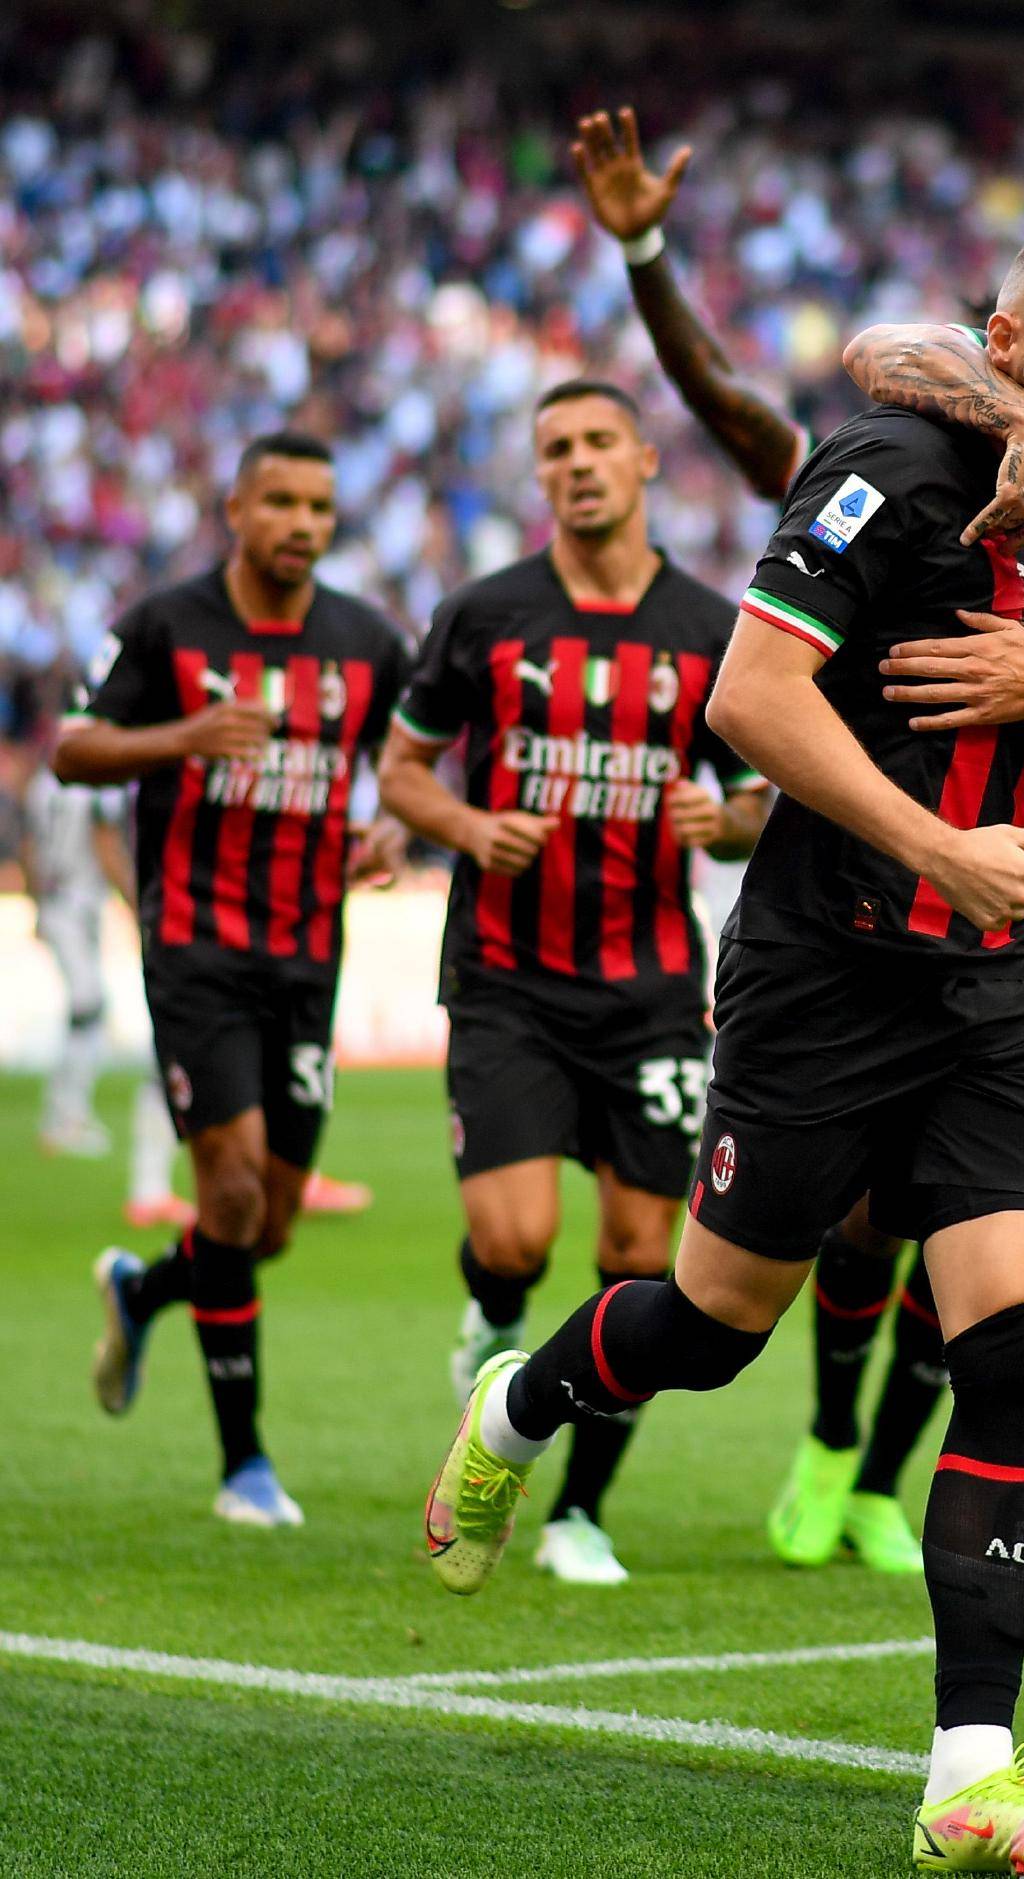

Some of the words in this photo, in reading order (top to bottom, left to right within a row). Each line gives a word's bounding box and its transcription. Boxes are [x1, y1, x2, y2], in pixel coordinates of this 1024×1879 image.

[826, 511, 847, 528] SERIE
[823, 530, 843, 549] TIM
[639, 1058, 707, 1133] 33
